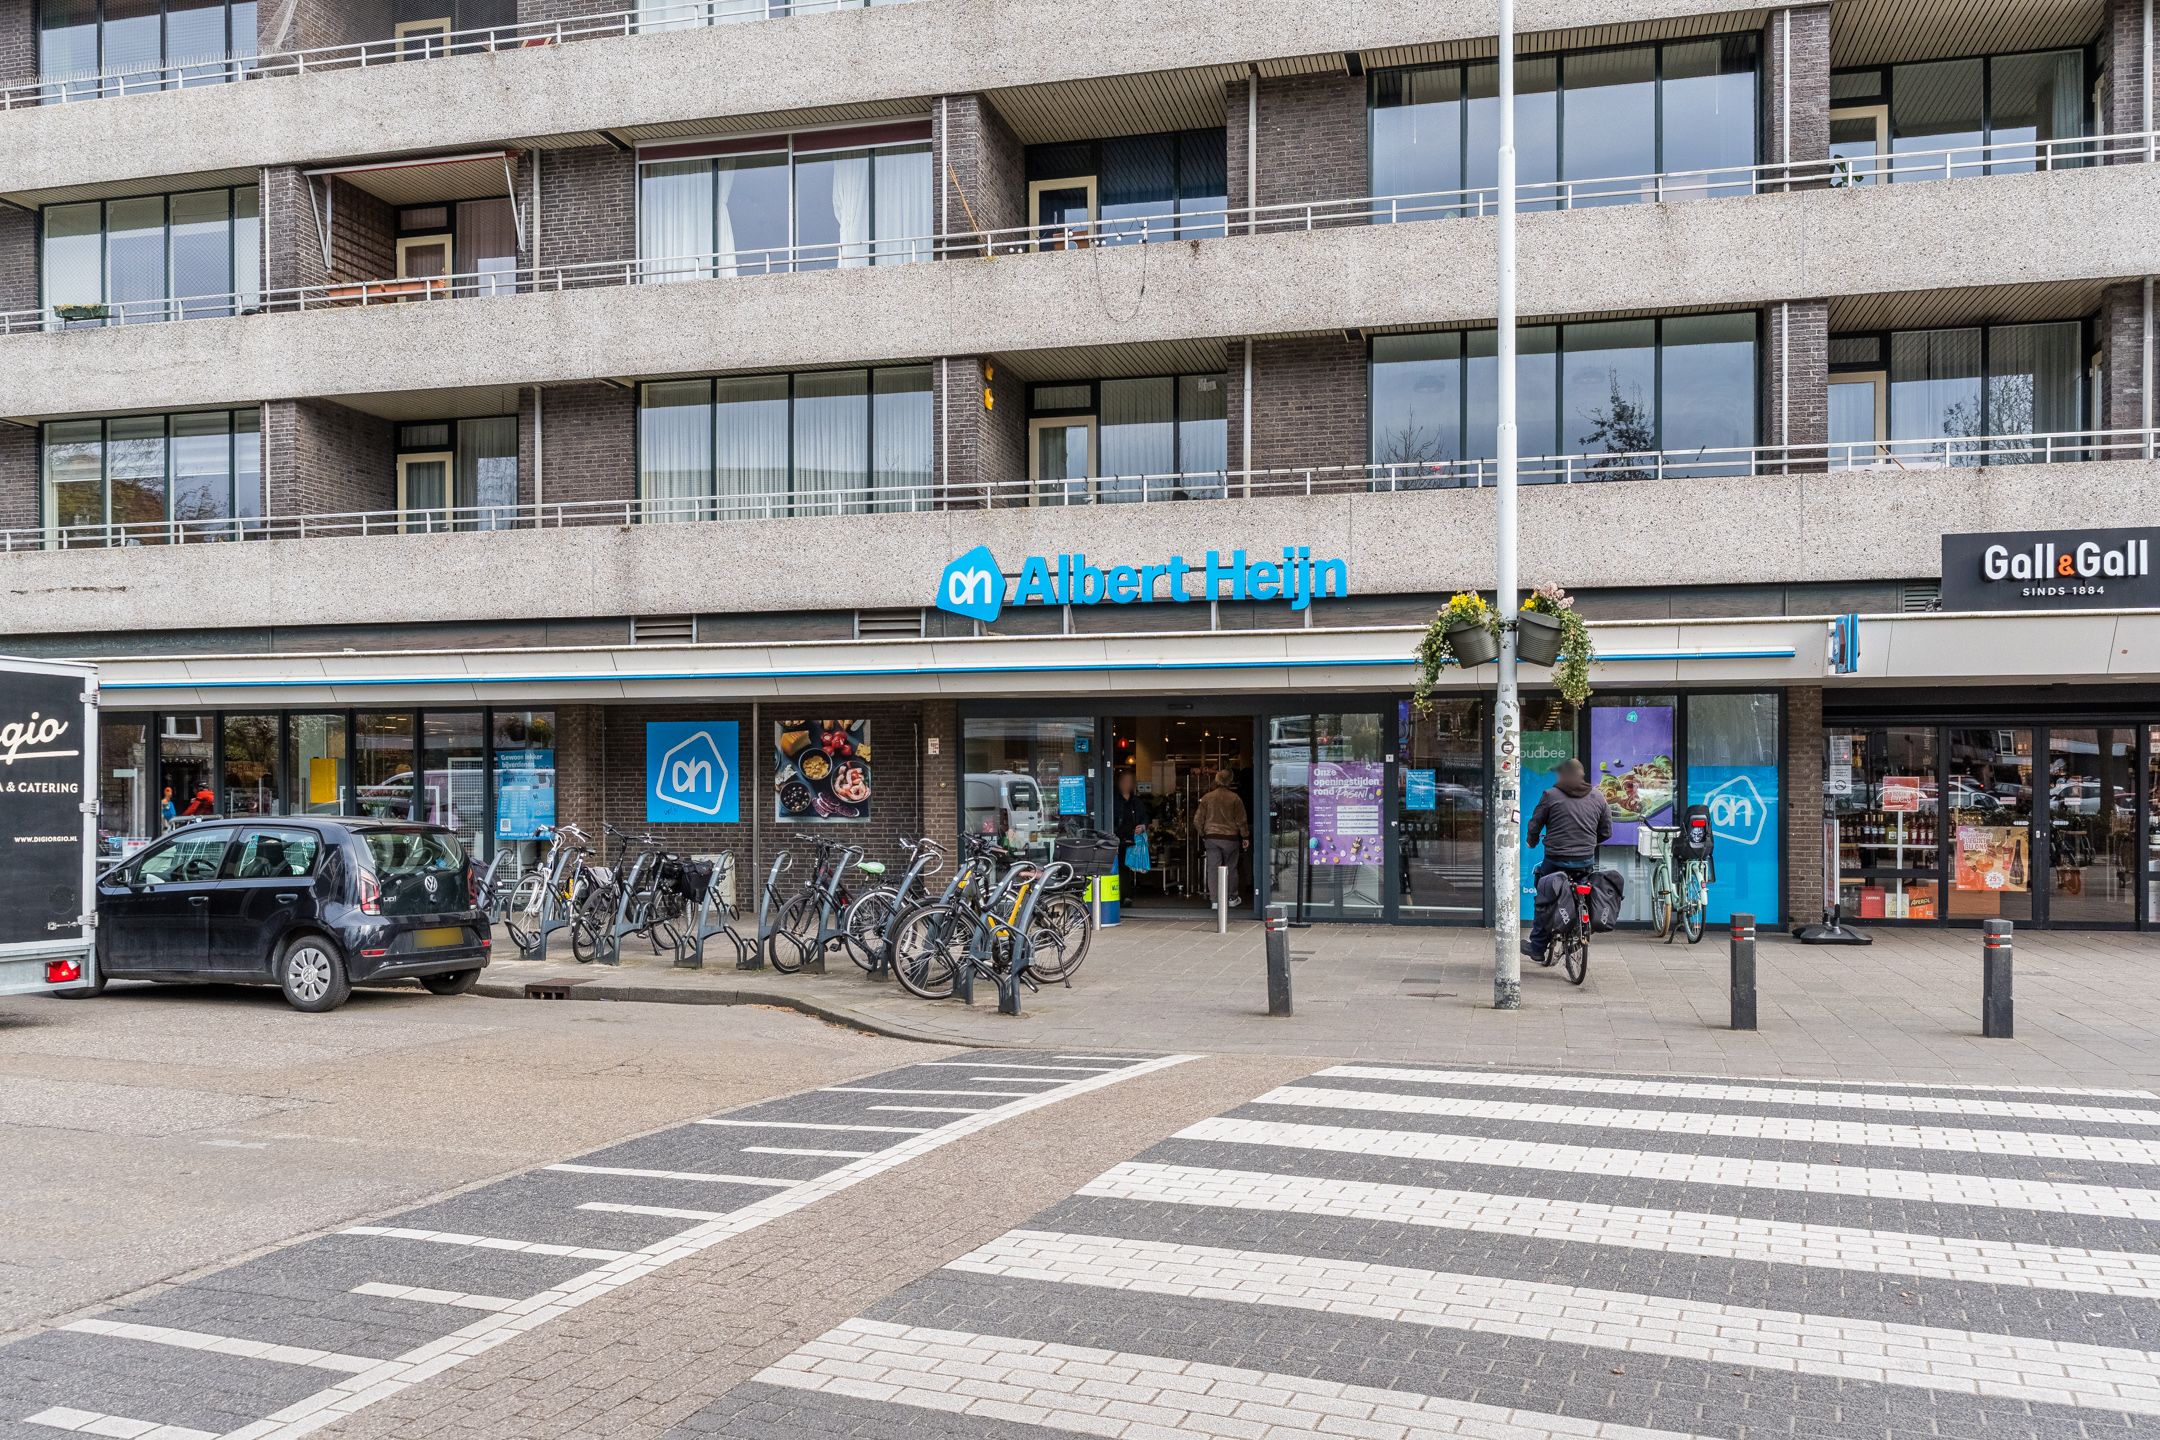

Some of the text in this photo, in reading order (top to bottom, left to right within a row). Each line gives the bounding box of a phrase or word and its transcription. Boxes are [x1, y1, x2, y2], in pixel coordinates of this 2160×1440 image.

[1012, 546, 1348, 610] Albert Heijn
[2022, 586, 2105, 596] SINDS 1884
[1313, 768, 1337, 777] Onze
[1313, 776, 1380, 787] openingstijden
[6, 781, 16, 792] &
[18, 782, 79, 793] CATERING
[1313, 786, 1335, 796] rond
